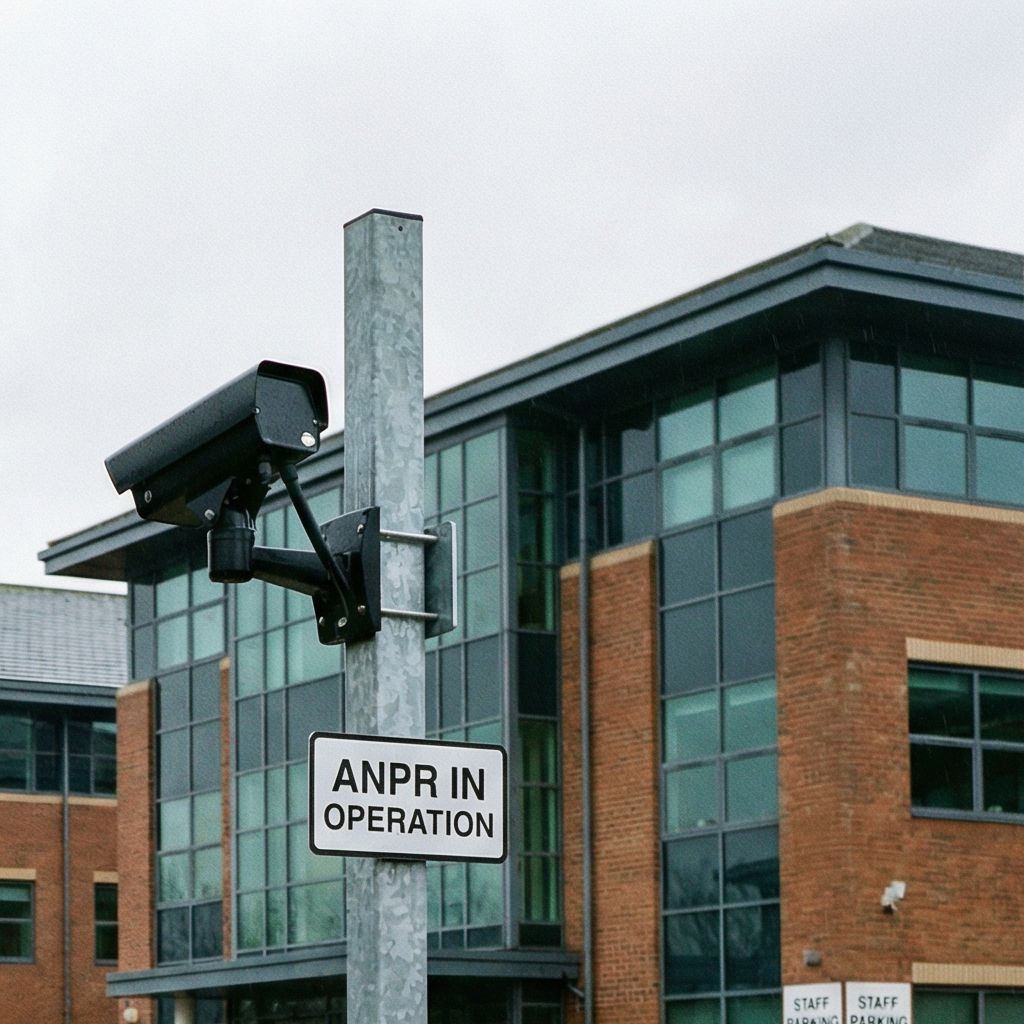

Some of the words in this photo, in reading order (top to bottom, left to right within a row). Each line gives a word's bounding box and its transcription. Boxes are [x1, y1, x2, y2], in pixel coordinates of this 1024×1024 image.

[332, 759, 437, 798] ANPR
[451, 767, 485, 800] IN
[324, 803, 494, 838] OPERATION
[793, 997, 829, 1011] STAFF
[858, 995, 898, 1010] STAFF
